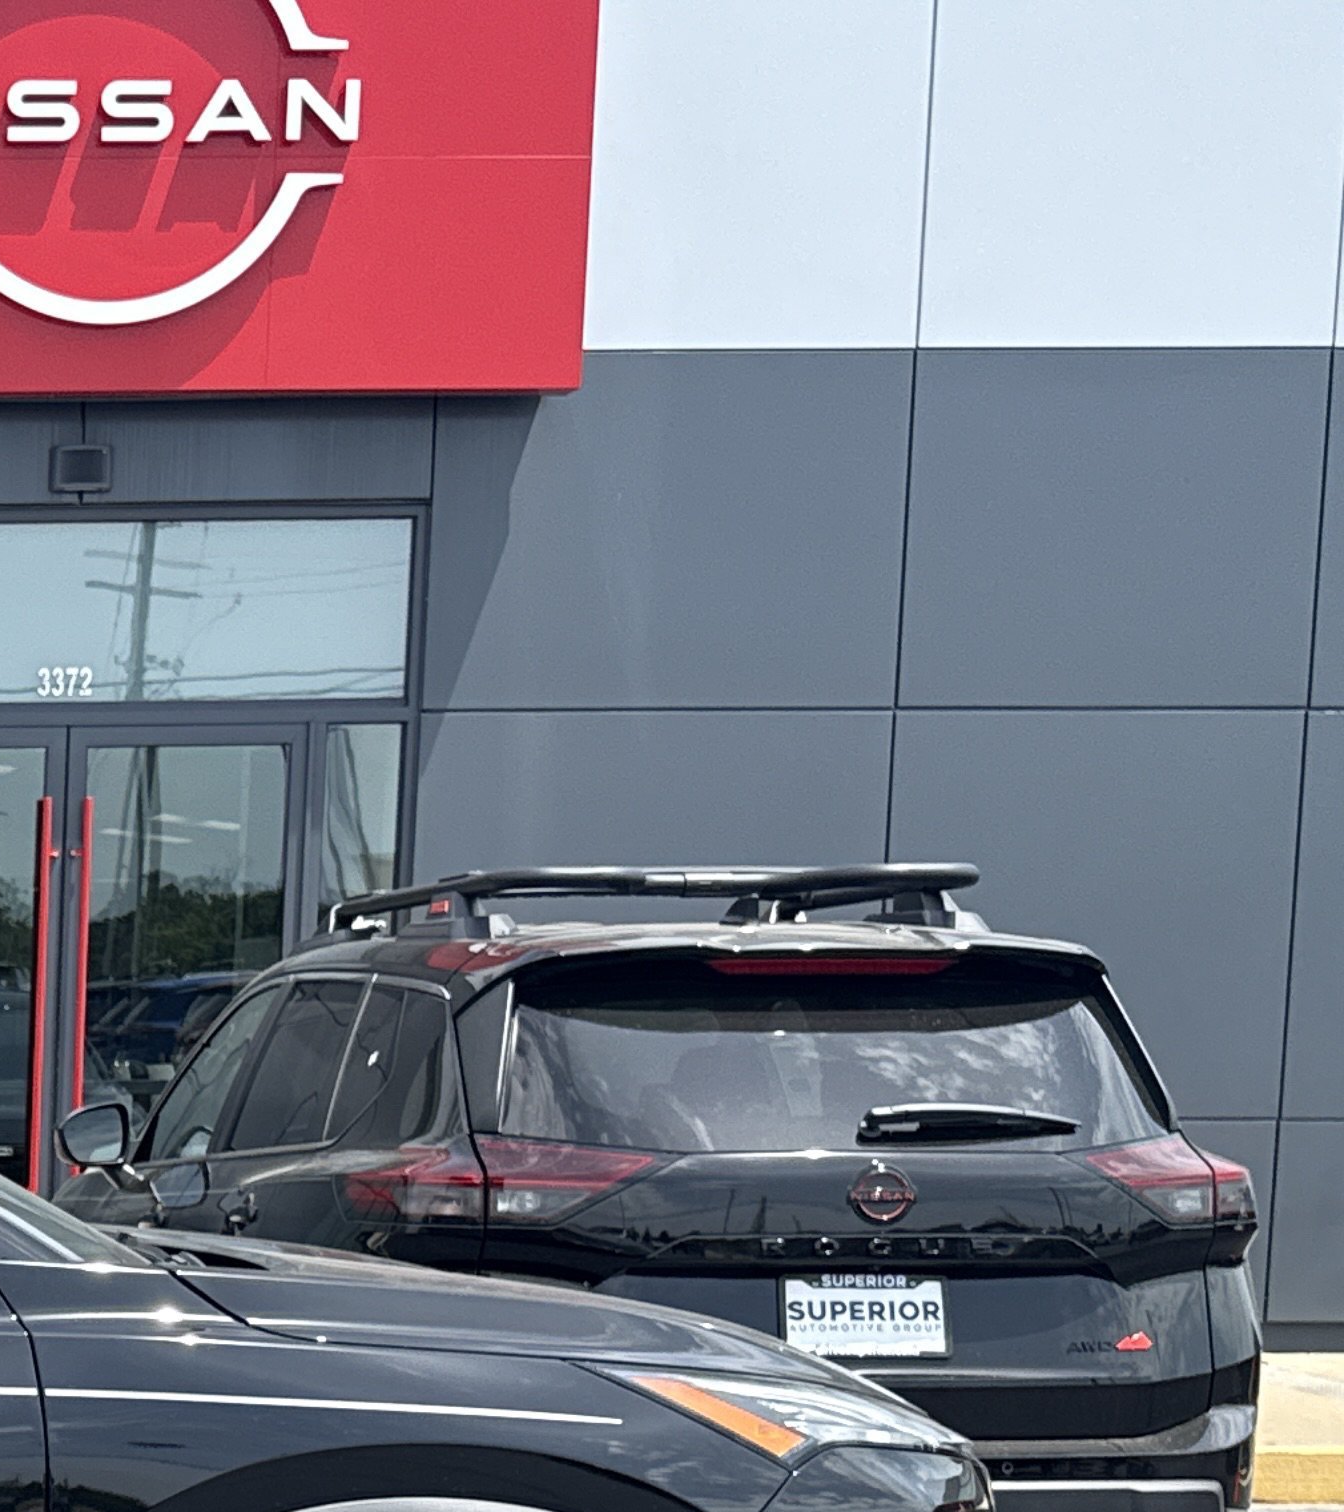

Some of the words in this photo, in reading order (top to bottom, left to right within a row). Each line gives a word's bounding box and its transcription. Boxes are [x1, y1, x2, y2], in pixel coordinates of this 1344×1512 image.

[37, 666, 92, 697] 3372
[820, 1274, 907, 1288] SUPERIOR
[787, 1300, 941, 1322] SUPERIOR
[789, 1322, 885, 1333] AUTOMOTIVE
[892, 1322, 942, 1333] GROUP
